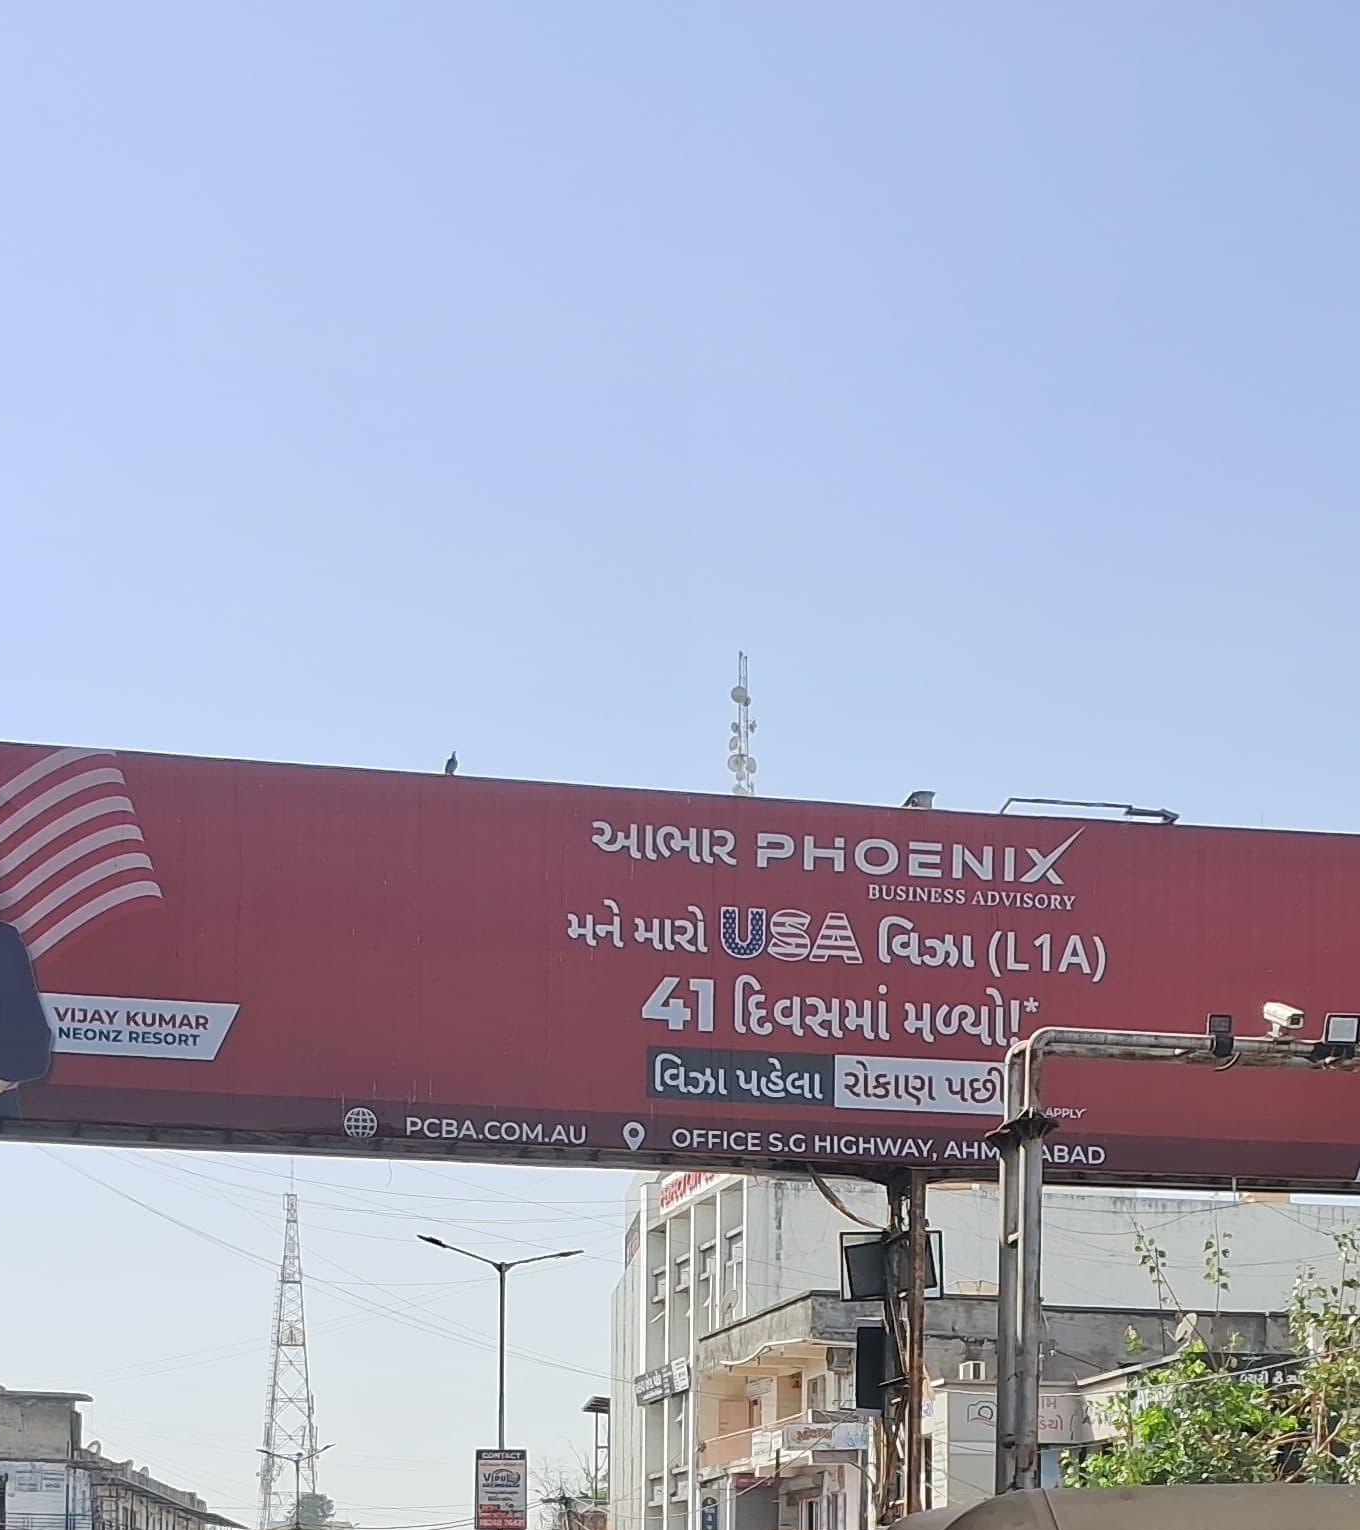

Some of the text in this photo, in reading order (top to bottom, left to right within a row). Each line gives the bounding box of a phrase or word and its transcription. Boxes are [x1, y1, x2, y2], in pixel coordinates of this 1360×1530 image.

[591, 820, 1086, 886] આભાર PHOENIX
[868, 883, 1076, 911] BUSINESS ADVISORY
[567, 898, 1107, 983] મને મારો USA વિઝા (L1A)
[54, 1006, 210, 1032] VIJAY KUMAR
[640, 976, 716, 1032] 41
[733, 974, 891, 1042] દિવસમાં
[57, 1027, 201, 1048] NEONZ RESORT
[653, 1051, 728, 1096] વિઝા
[736, 1056, 824, 1100] પહેલા
[842, 1060, 935, 1105] રોકાણ
[404, 1115, 587, 1146] PCBA.COM.AU
[671, 1127, 762, 1152] OFFICE
[768, 1131, 808, 1154] S.G
[813, 1133, 940, 1162] HIGHWAY,
